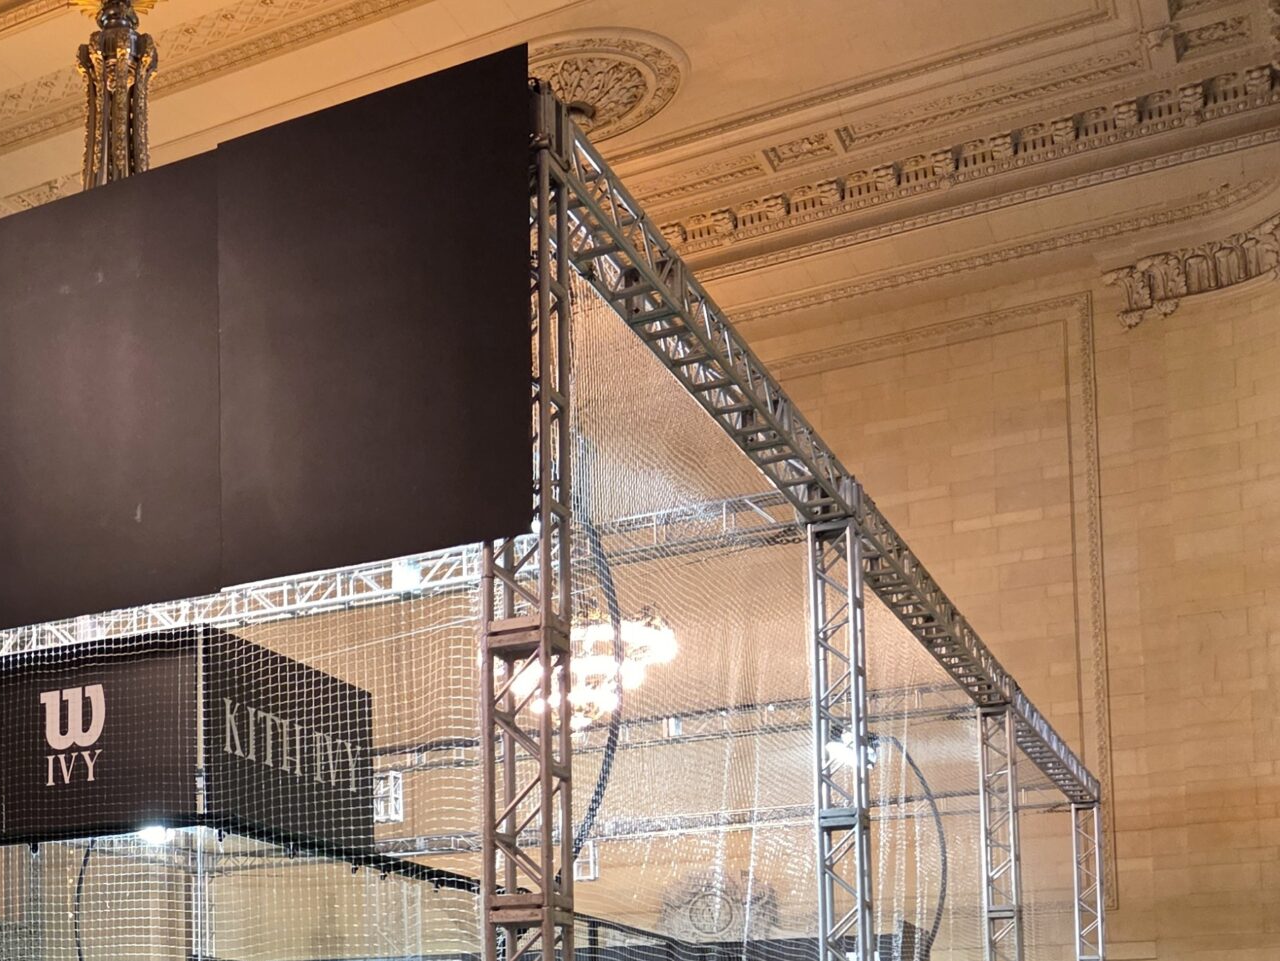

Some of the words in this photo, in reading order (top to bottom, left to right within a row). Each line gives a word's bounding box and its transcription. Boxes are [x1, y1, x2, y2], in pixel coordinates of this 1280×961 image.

[45, 749, 103, 787] IVY
[223, 698, 302, 777] KITH
[312, 731, 360, 793] IVY
